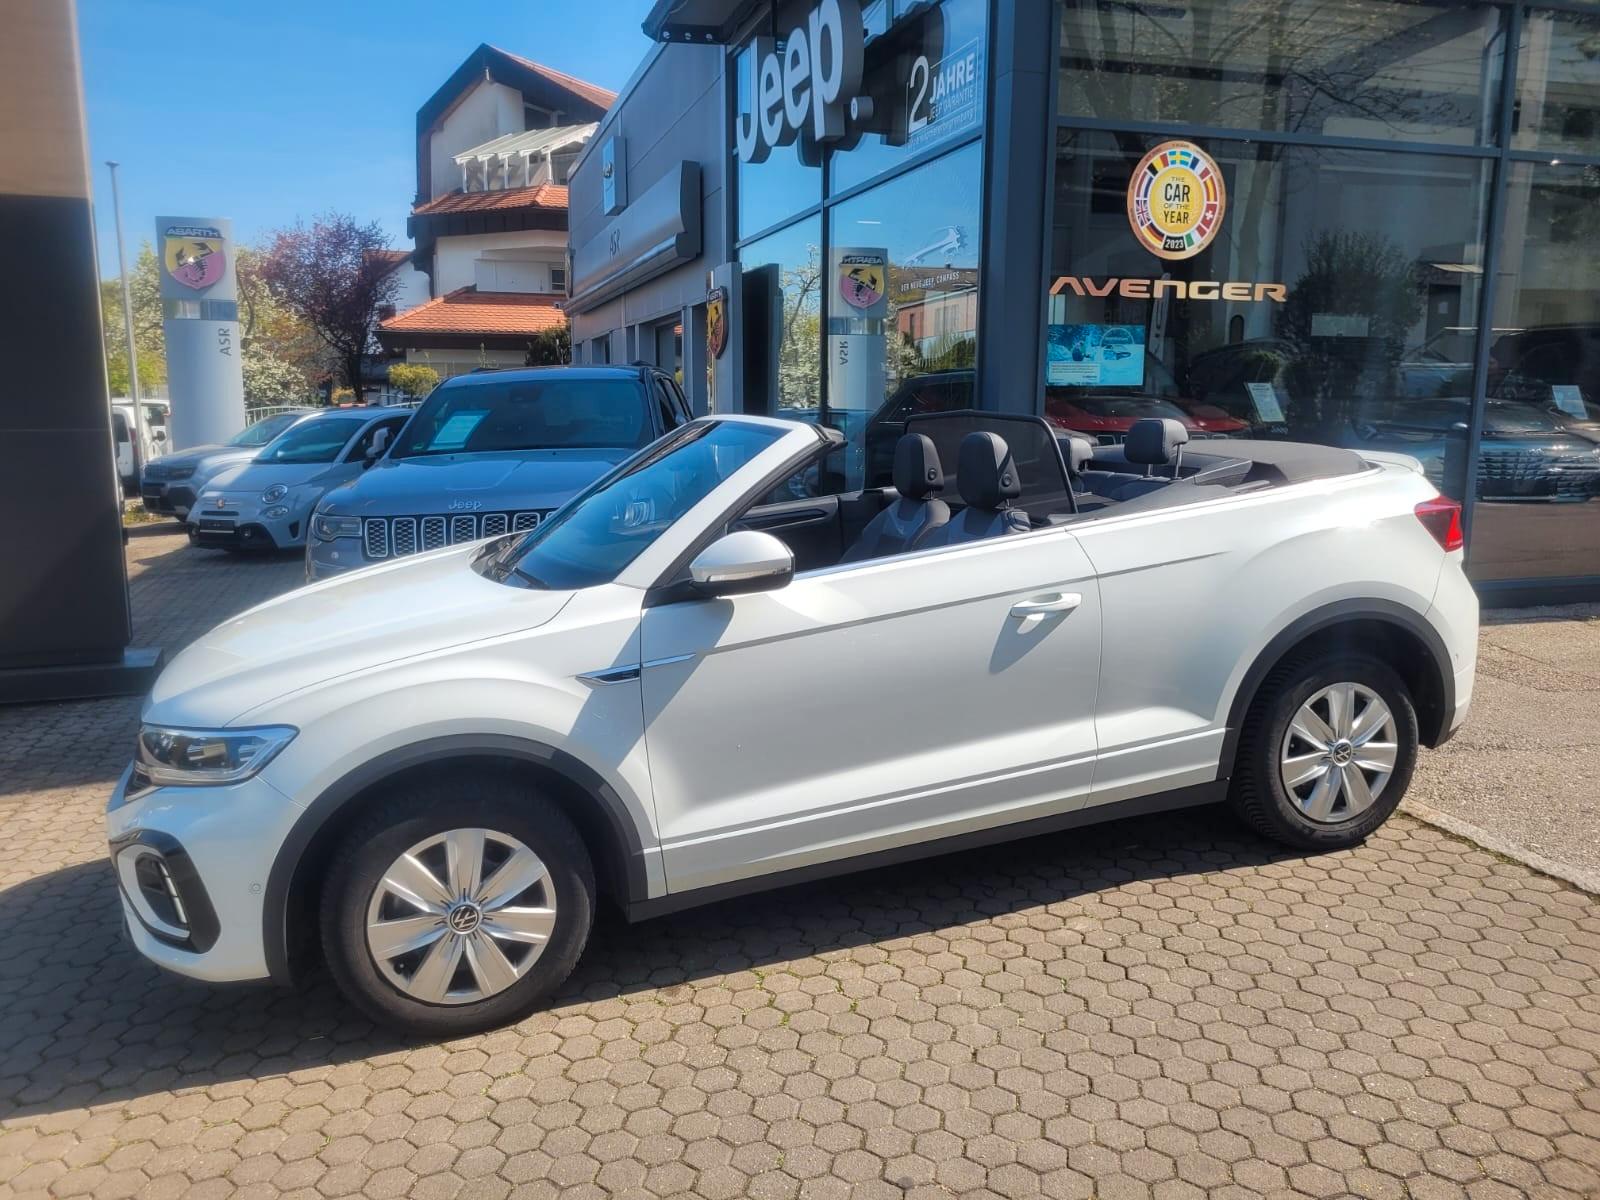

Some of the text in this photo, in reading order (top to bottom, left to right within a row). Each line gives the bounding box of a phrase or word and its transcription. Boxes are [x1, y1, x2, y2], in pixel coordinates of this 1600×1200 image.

[736, 0, 843, 163] Jeep
[908, 52, 975, 134] 2 JAHRE
[1164, 183, 1191, 203] CAR
[1163, 211, 1190, 224] YEAR
[167, 228, 219, 237] ABARTH
[1165, 239, 1184, 249] 2023
[1050, 276, 1288, 302] AVENGER
[218, 327, 231, 356] ASR
[448, 499, 482, 511] Jeep
